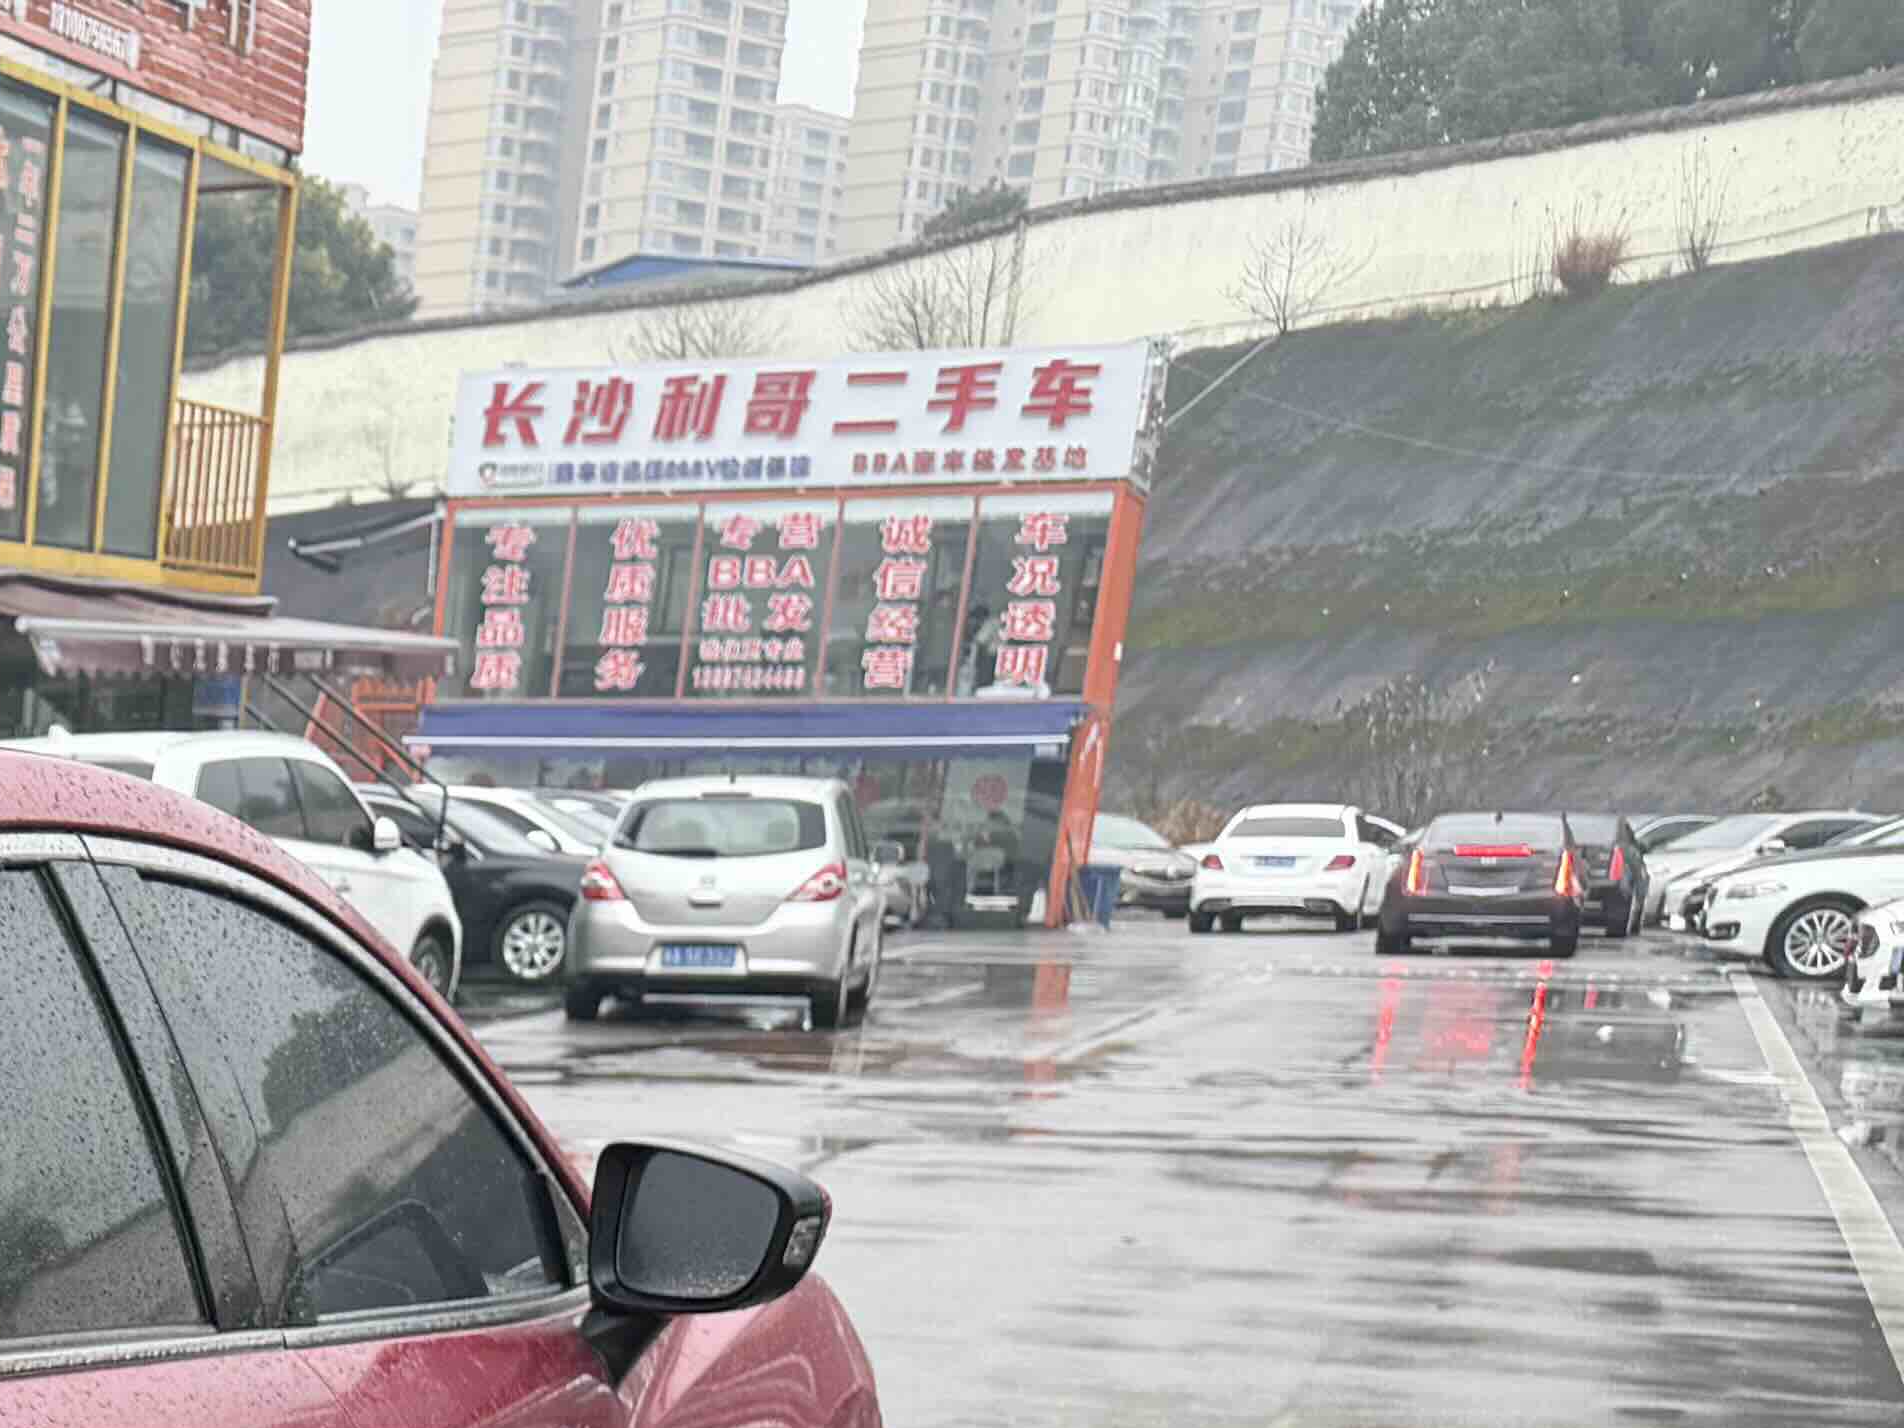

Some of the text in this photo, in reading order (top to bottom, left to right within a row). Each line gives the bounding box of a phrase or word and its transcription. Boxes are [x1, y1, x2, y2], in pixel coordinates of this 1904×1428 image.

[482, 358, 1101, 449] 长沙利哥二手车
[708, 555, 815, 590] BBA
[713, 513, 825, 549] 专营
[471, 523, 535, 690] 专注品质
[594, 518, 660, 691] 优质服务
[702, 592, 813, 632] 批发
[862, 516, 932, 689] 诚信经营
[996, 513, 1068, 686] 车况透明
